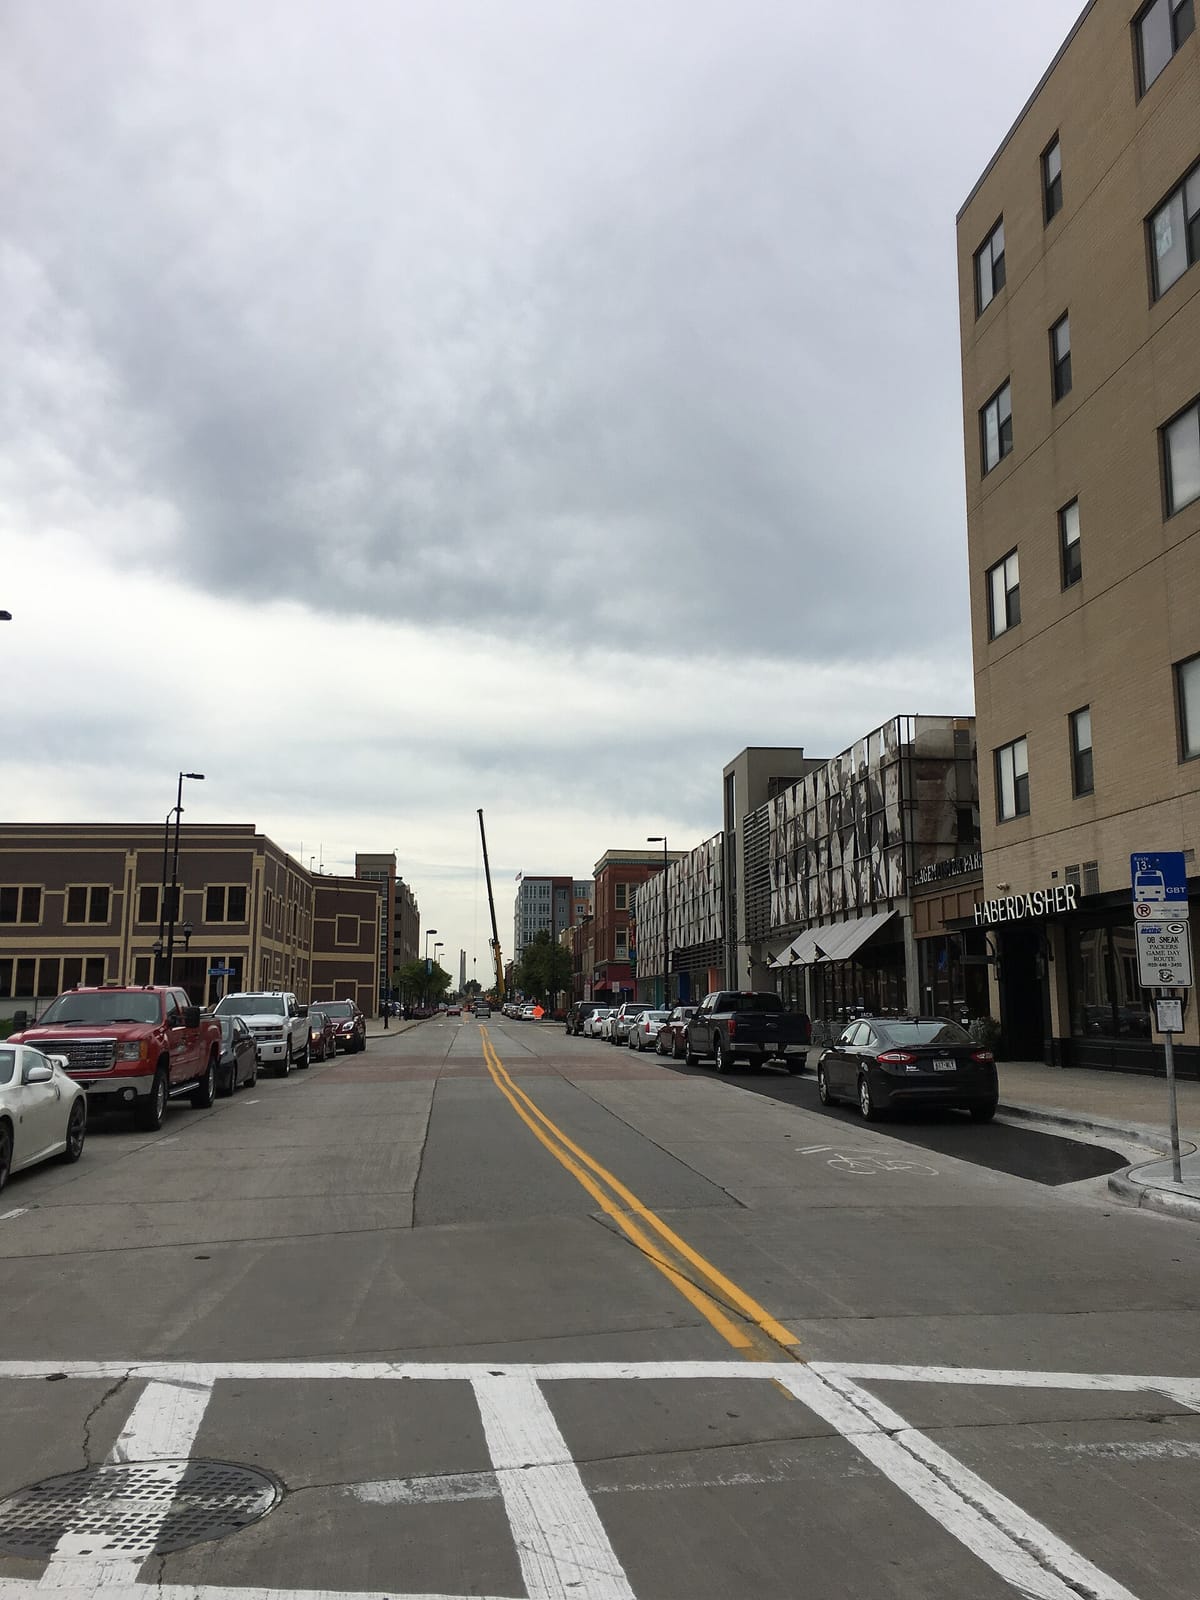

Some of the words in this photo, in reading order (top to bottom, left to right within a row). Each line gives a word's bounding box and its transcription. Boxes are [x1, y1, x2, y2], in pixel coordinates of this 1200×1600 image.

[1166, 886, 1186, 894] GBT
[973, 883, 1078, 926] HABERDASHER
[1159, 936, 1180, 944] SNEAK
